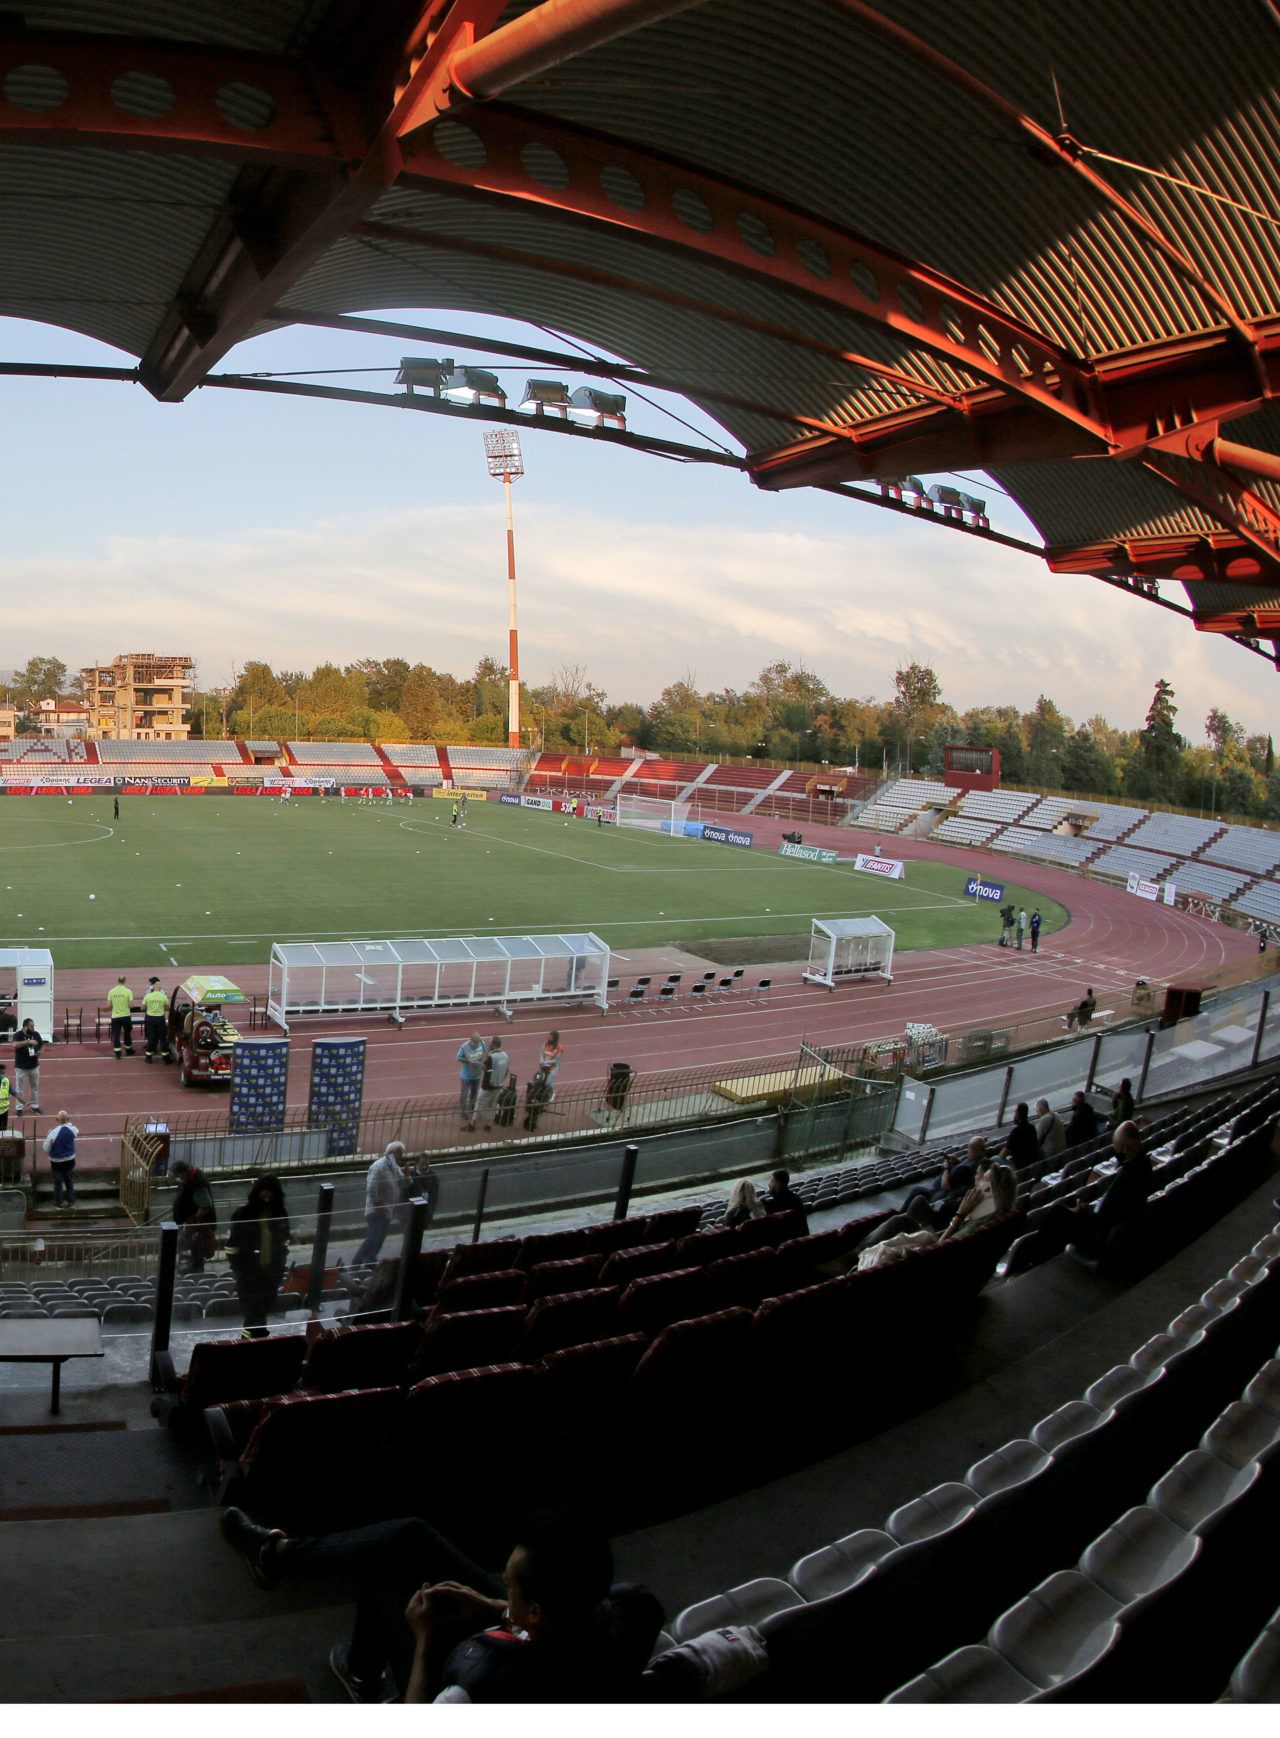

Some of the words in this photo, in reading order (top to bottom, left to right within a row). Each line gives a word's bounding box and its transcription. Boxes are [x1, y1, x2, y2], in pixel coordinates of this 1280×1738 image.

[710, 831, 726, 840] nova
[734, 835, 750, 845] nova
[781, 843, 819, 860] Hellasod
[977, 885, 1001, 899] nova
